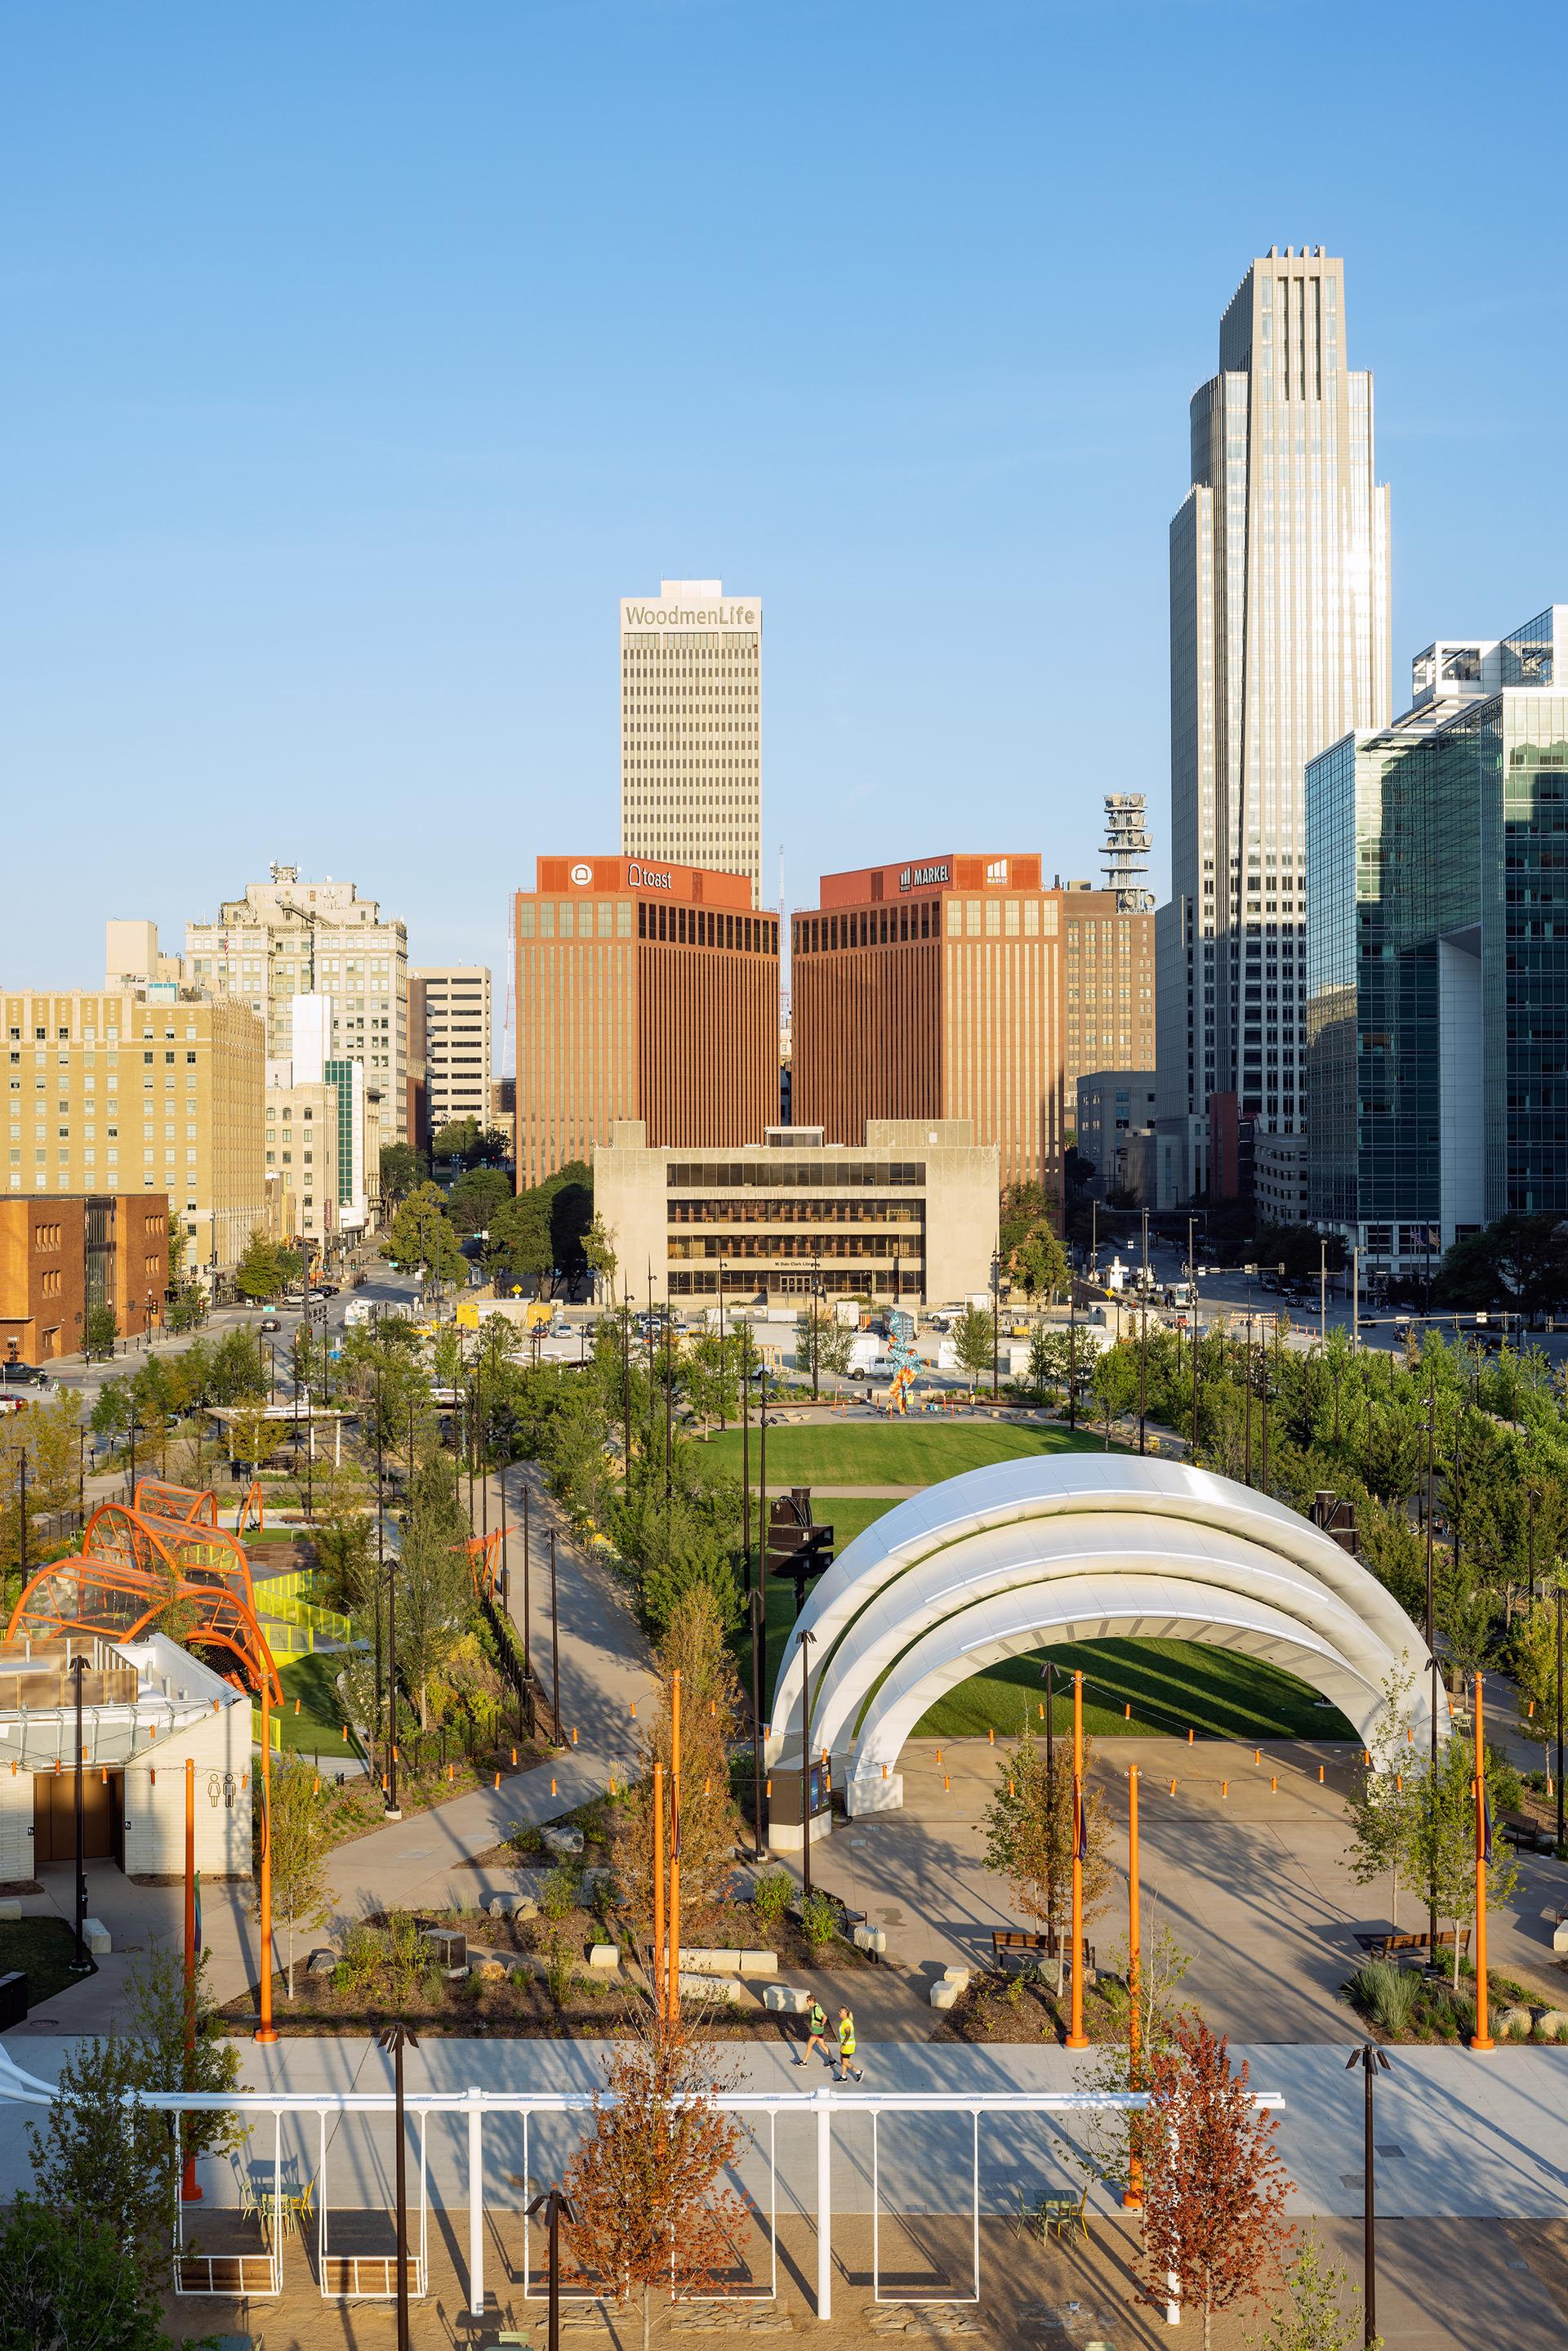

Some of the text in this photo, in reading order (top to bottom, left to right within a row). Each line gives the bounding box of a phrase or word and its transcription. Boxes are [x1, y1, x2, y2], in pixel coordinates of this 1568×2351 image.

[626, 605, 755, 625] WoodmenLife
[642, 868, 672, 890] toast
[914, 865, 950, 886] MARKEL
